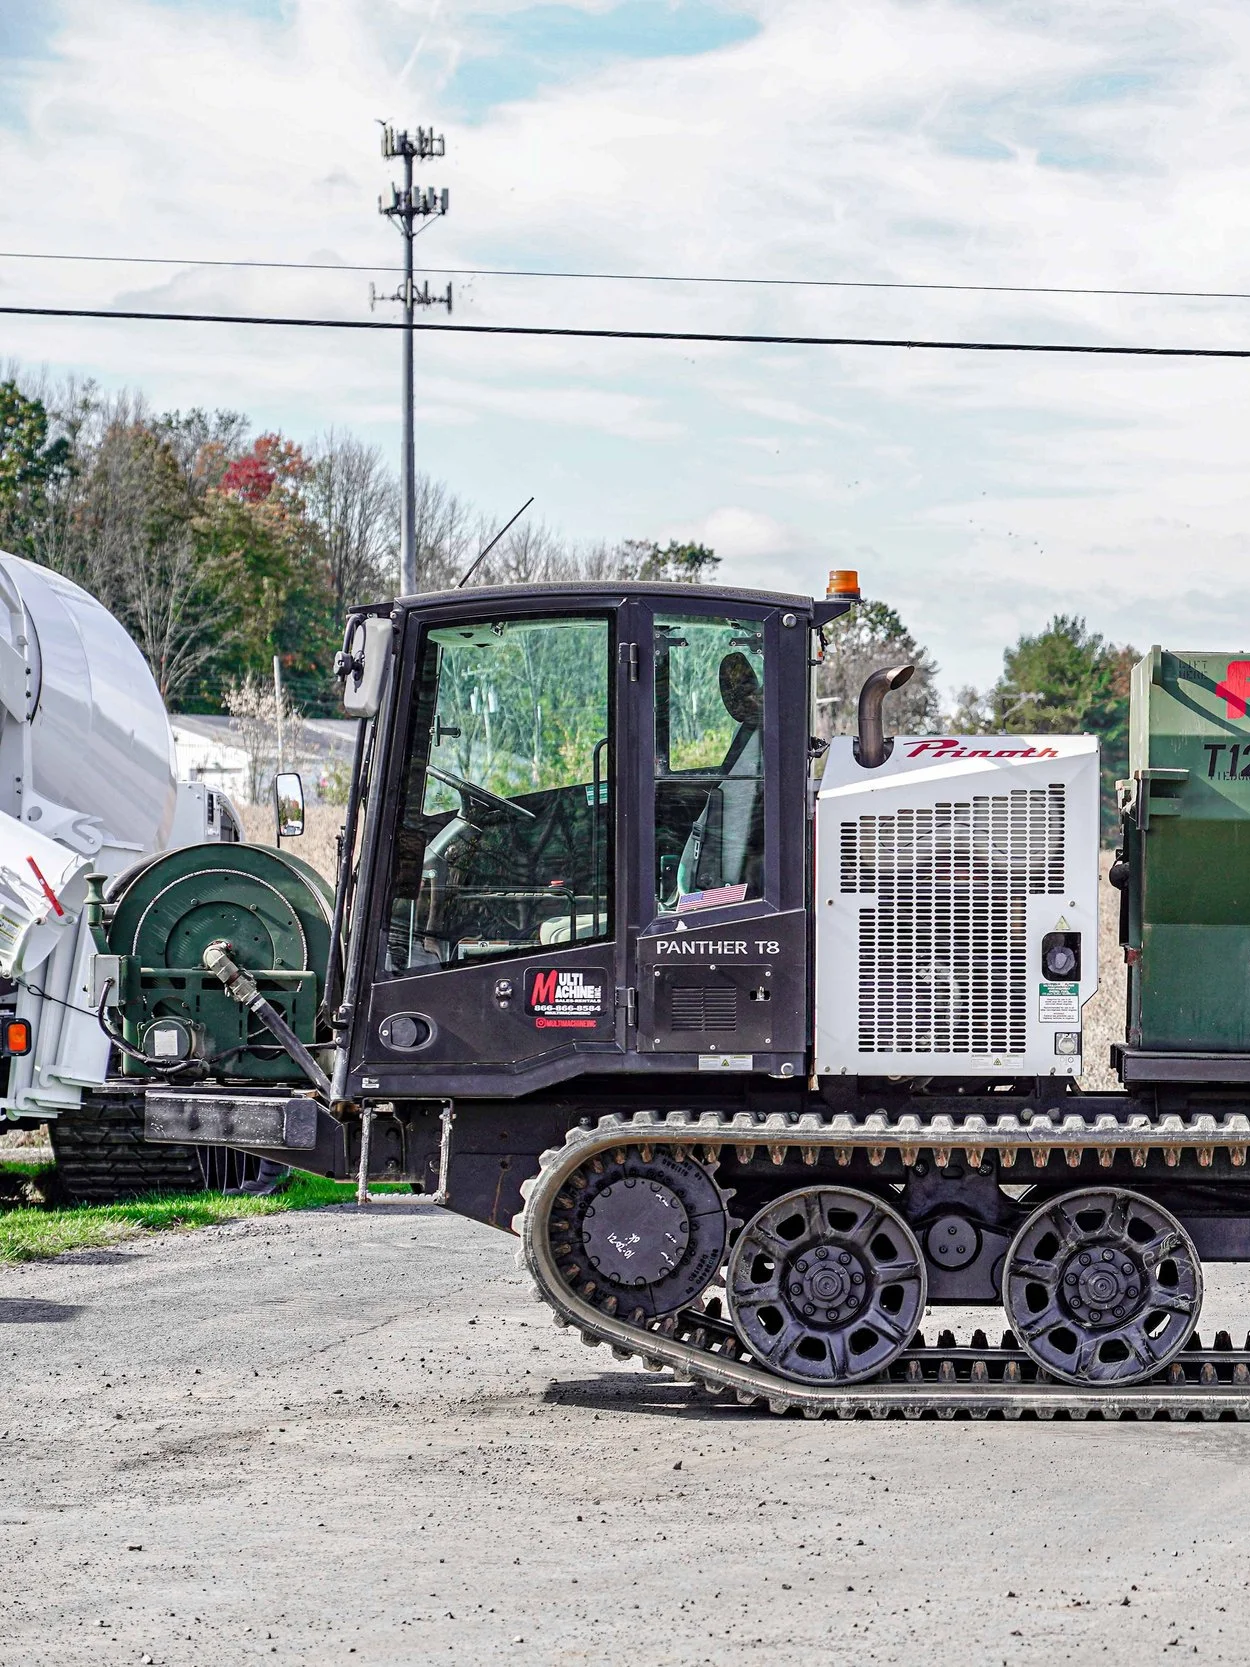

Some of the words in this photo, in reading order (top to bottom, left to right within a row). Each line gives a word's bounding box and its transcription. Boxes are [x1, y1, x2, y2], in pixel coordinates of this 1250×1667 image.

[656, 940, 748, 955] PANTHER
[754, 940, 780, 955] T8
[534, 1004, 602, 1012] 866-866-8584
